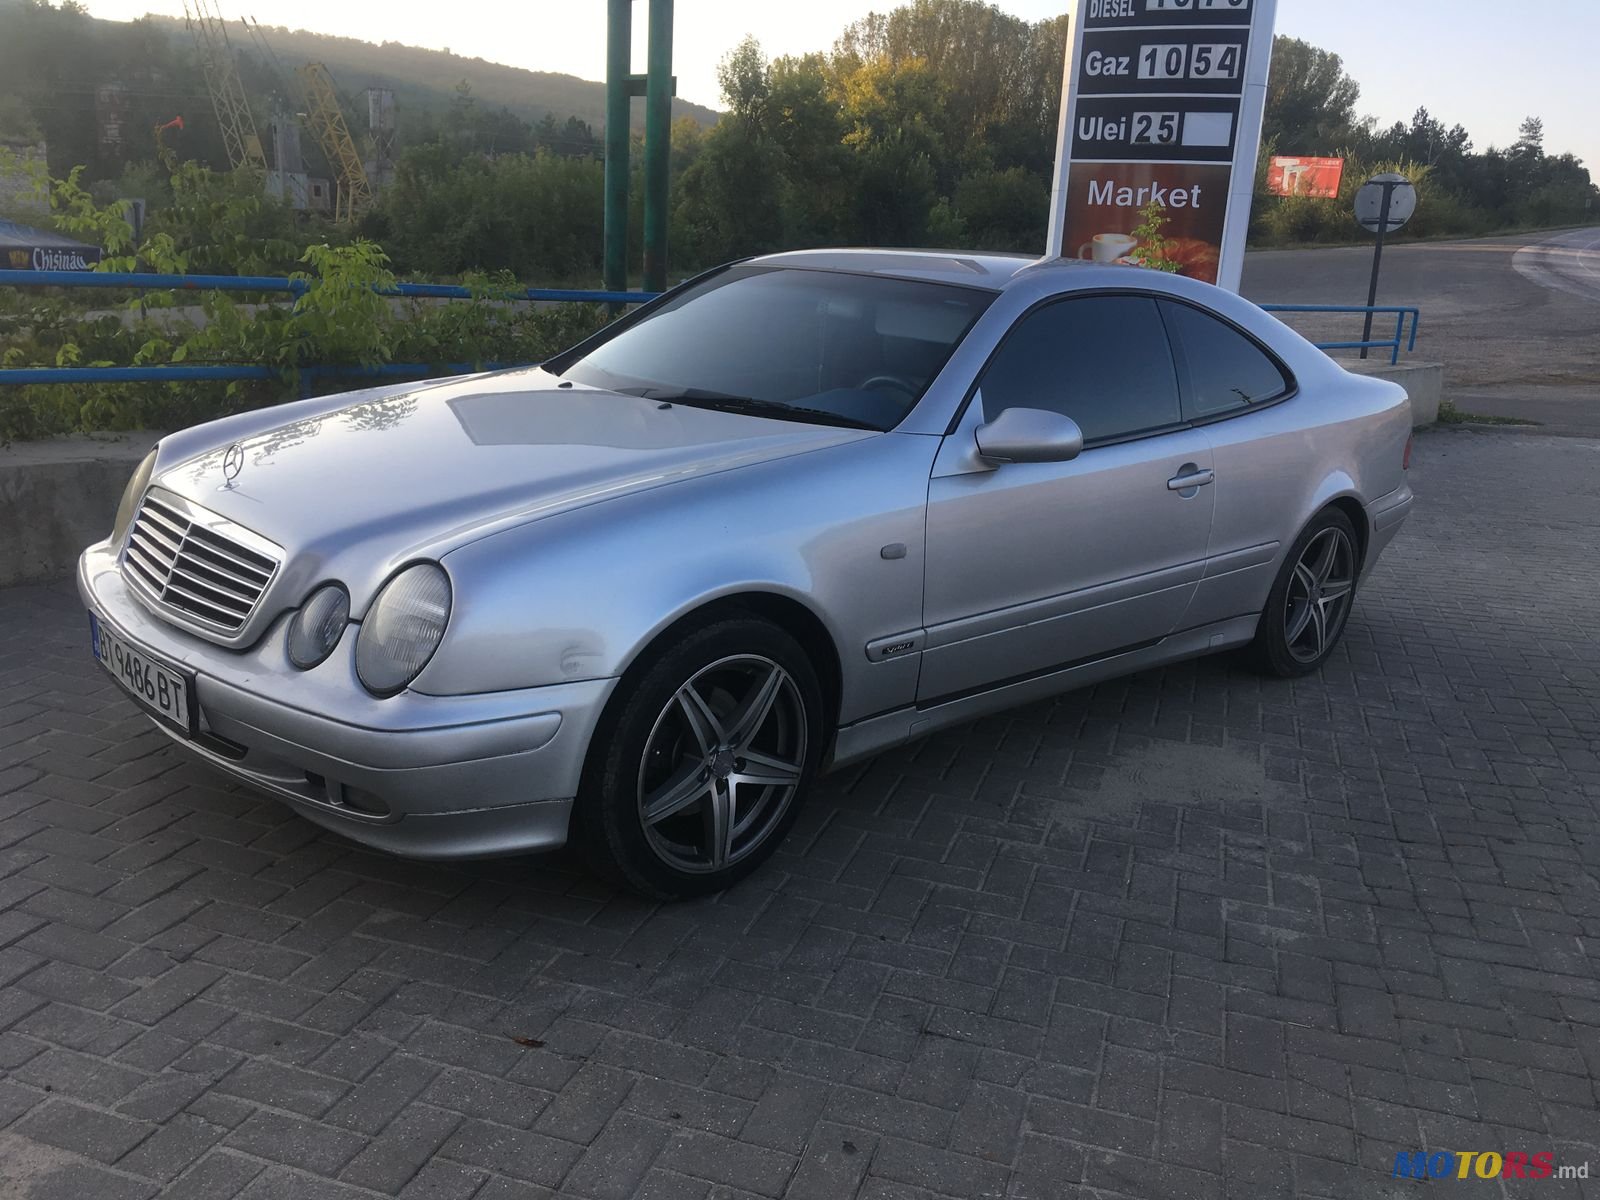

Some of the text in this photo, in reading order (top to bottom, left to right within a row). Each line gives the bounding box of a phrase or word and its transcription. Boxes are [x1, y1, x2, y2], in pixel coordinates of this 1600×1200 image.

[1090, 0, 1135, 18] DIESEL
[1085, 51, 1130, 76] Gaz
[1078, 115, 1175, 143] Ulei 25
[1087, 180, 1201, 208] Market
